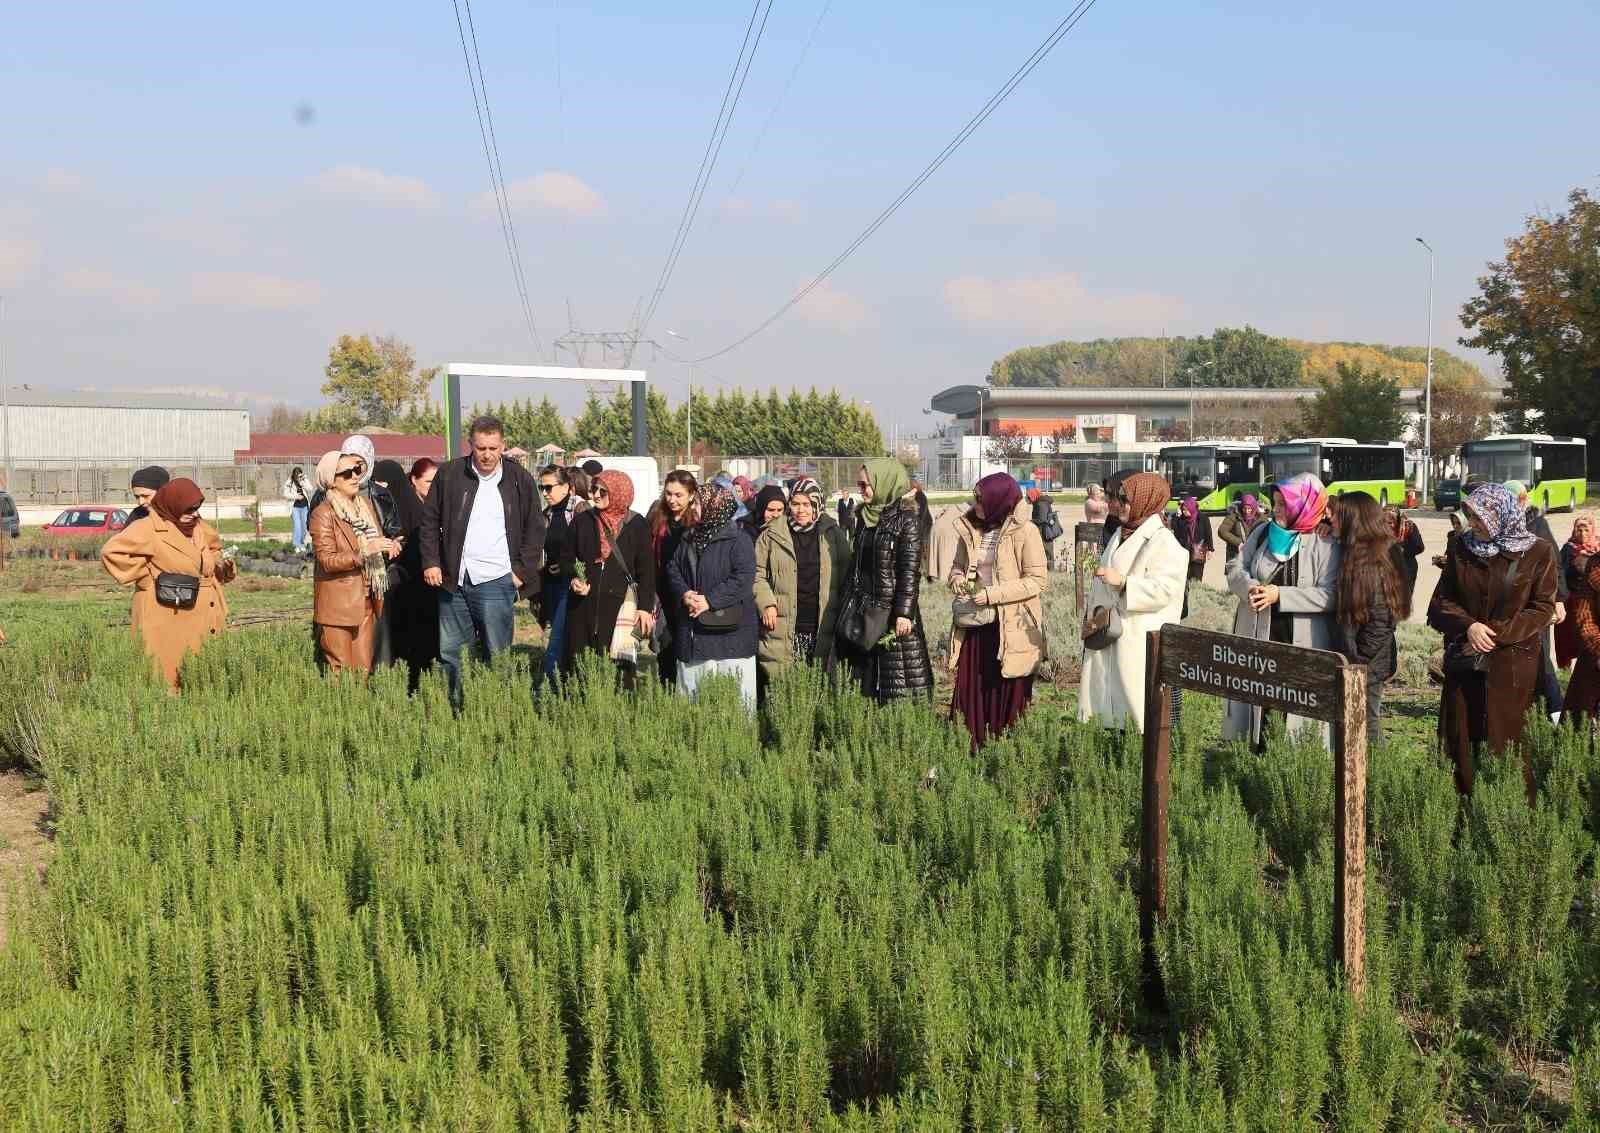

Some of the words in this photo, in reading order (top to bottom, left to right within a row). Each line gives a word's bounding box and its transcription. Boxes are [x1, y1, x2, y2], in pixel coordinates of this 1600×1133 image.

[1212, 644, 1277, 674] Biberiye
[1179, 662, 1222, 686] Salvia
[1225, 675, 1317, 707] rosmarinus
